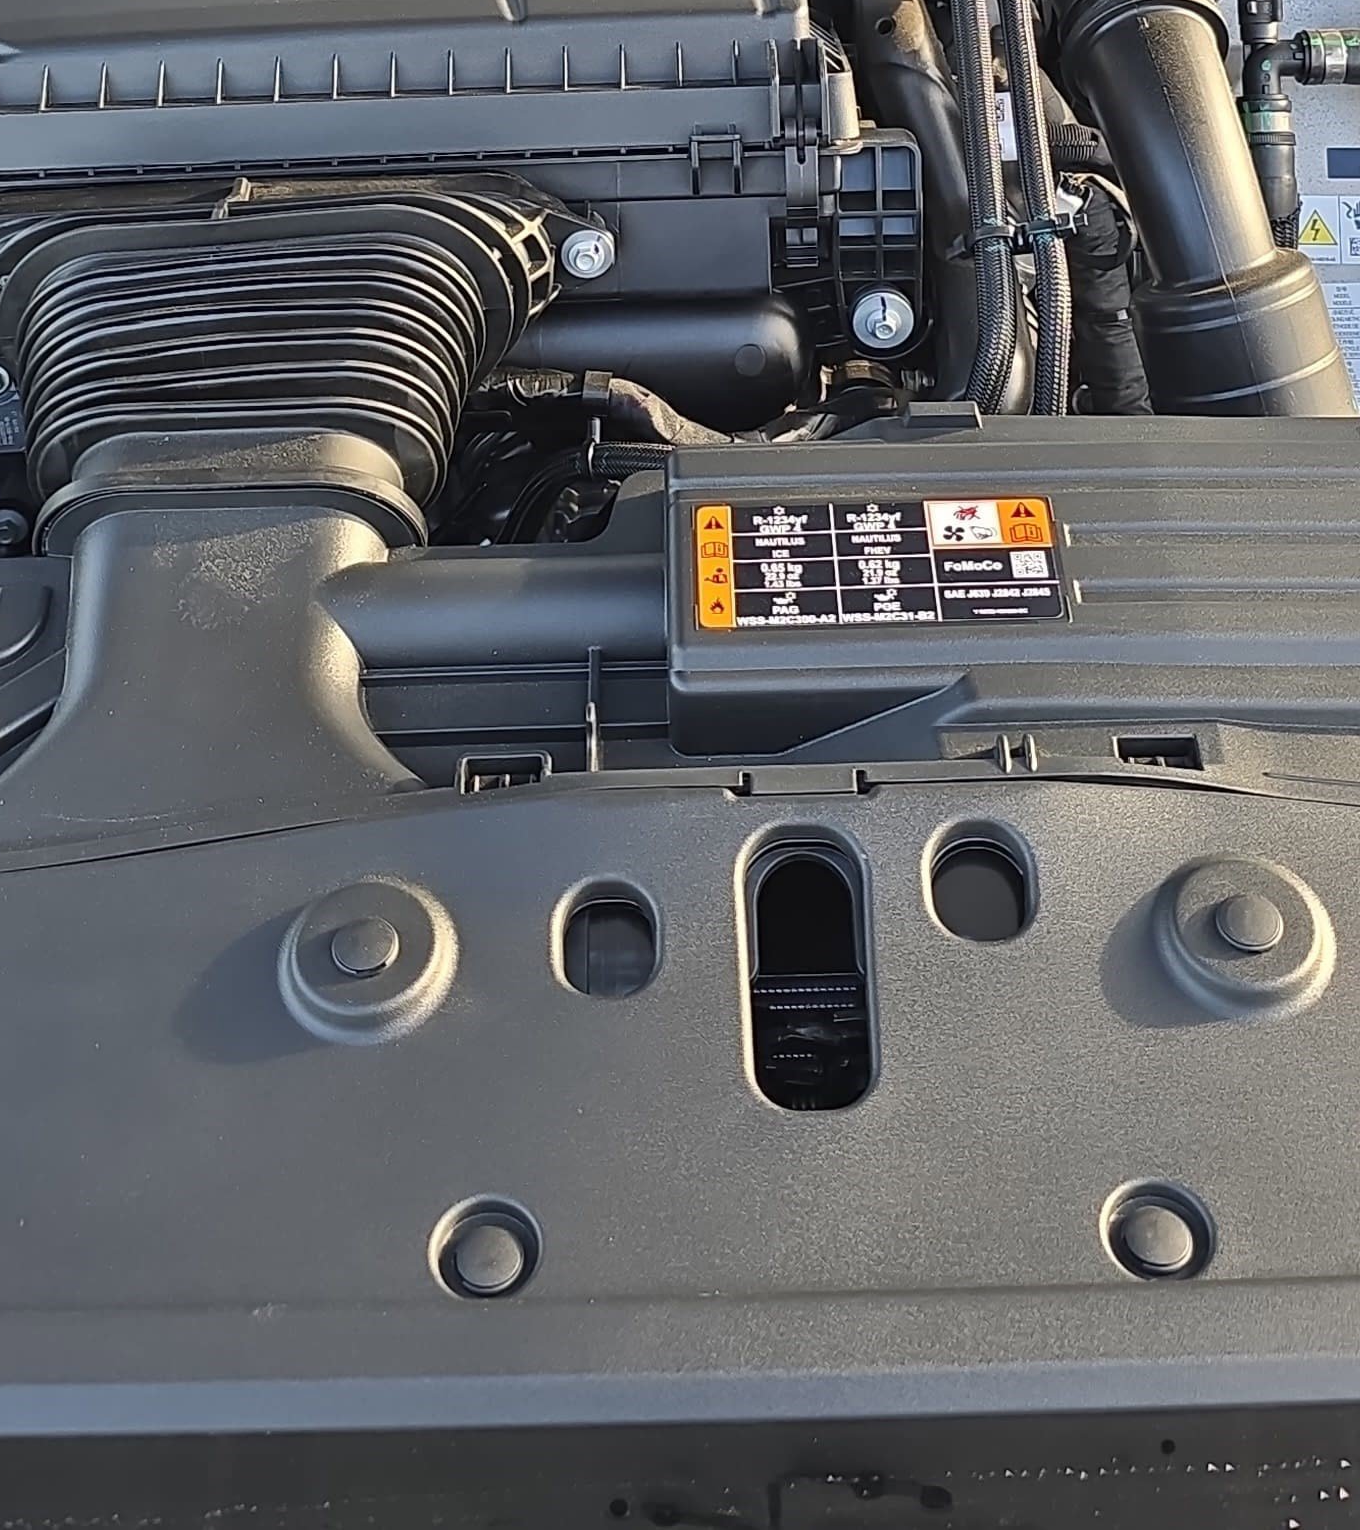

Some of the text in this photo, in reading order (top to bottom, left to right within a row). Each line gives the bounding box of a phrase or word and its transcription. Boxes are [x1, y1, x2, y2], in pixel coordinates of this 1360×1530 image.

[752, 515, 809, 528] R-1234yf
[846, 512, 902, 526] R-1234yf
[760, 525, 791, 533] GWP
[853, 522, 885, 530] GWP
[755, 537, 806, 546] NAUTILUS
[851, 534, 902, 543] NAUTILUS
[772, 550, 790, 558] ICE
[864, 546, 891, 555] FHEV
[760, 562, 803, 574] 0.65 kg
[858, 559, 901, 571] 0.62 kg
[943, 560, 1003, 571] FoMoCo
[772, 605, 800, 614] PAG
